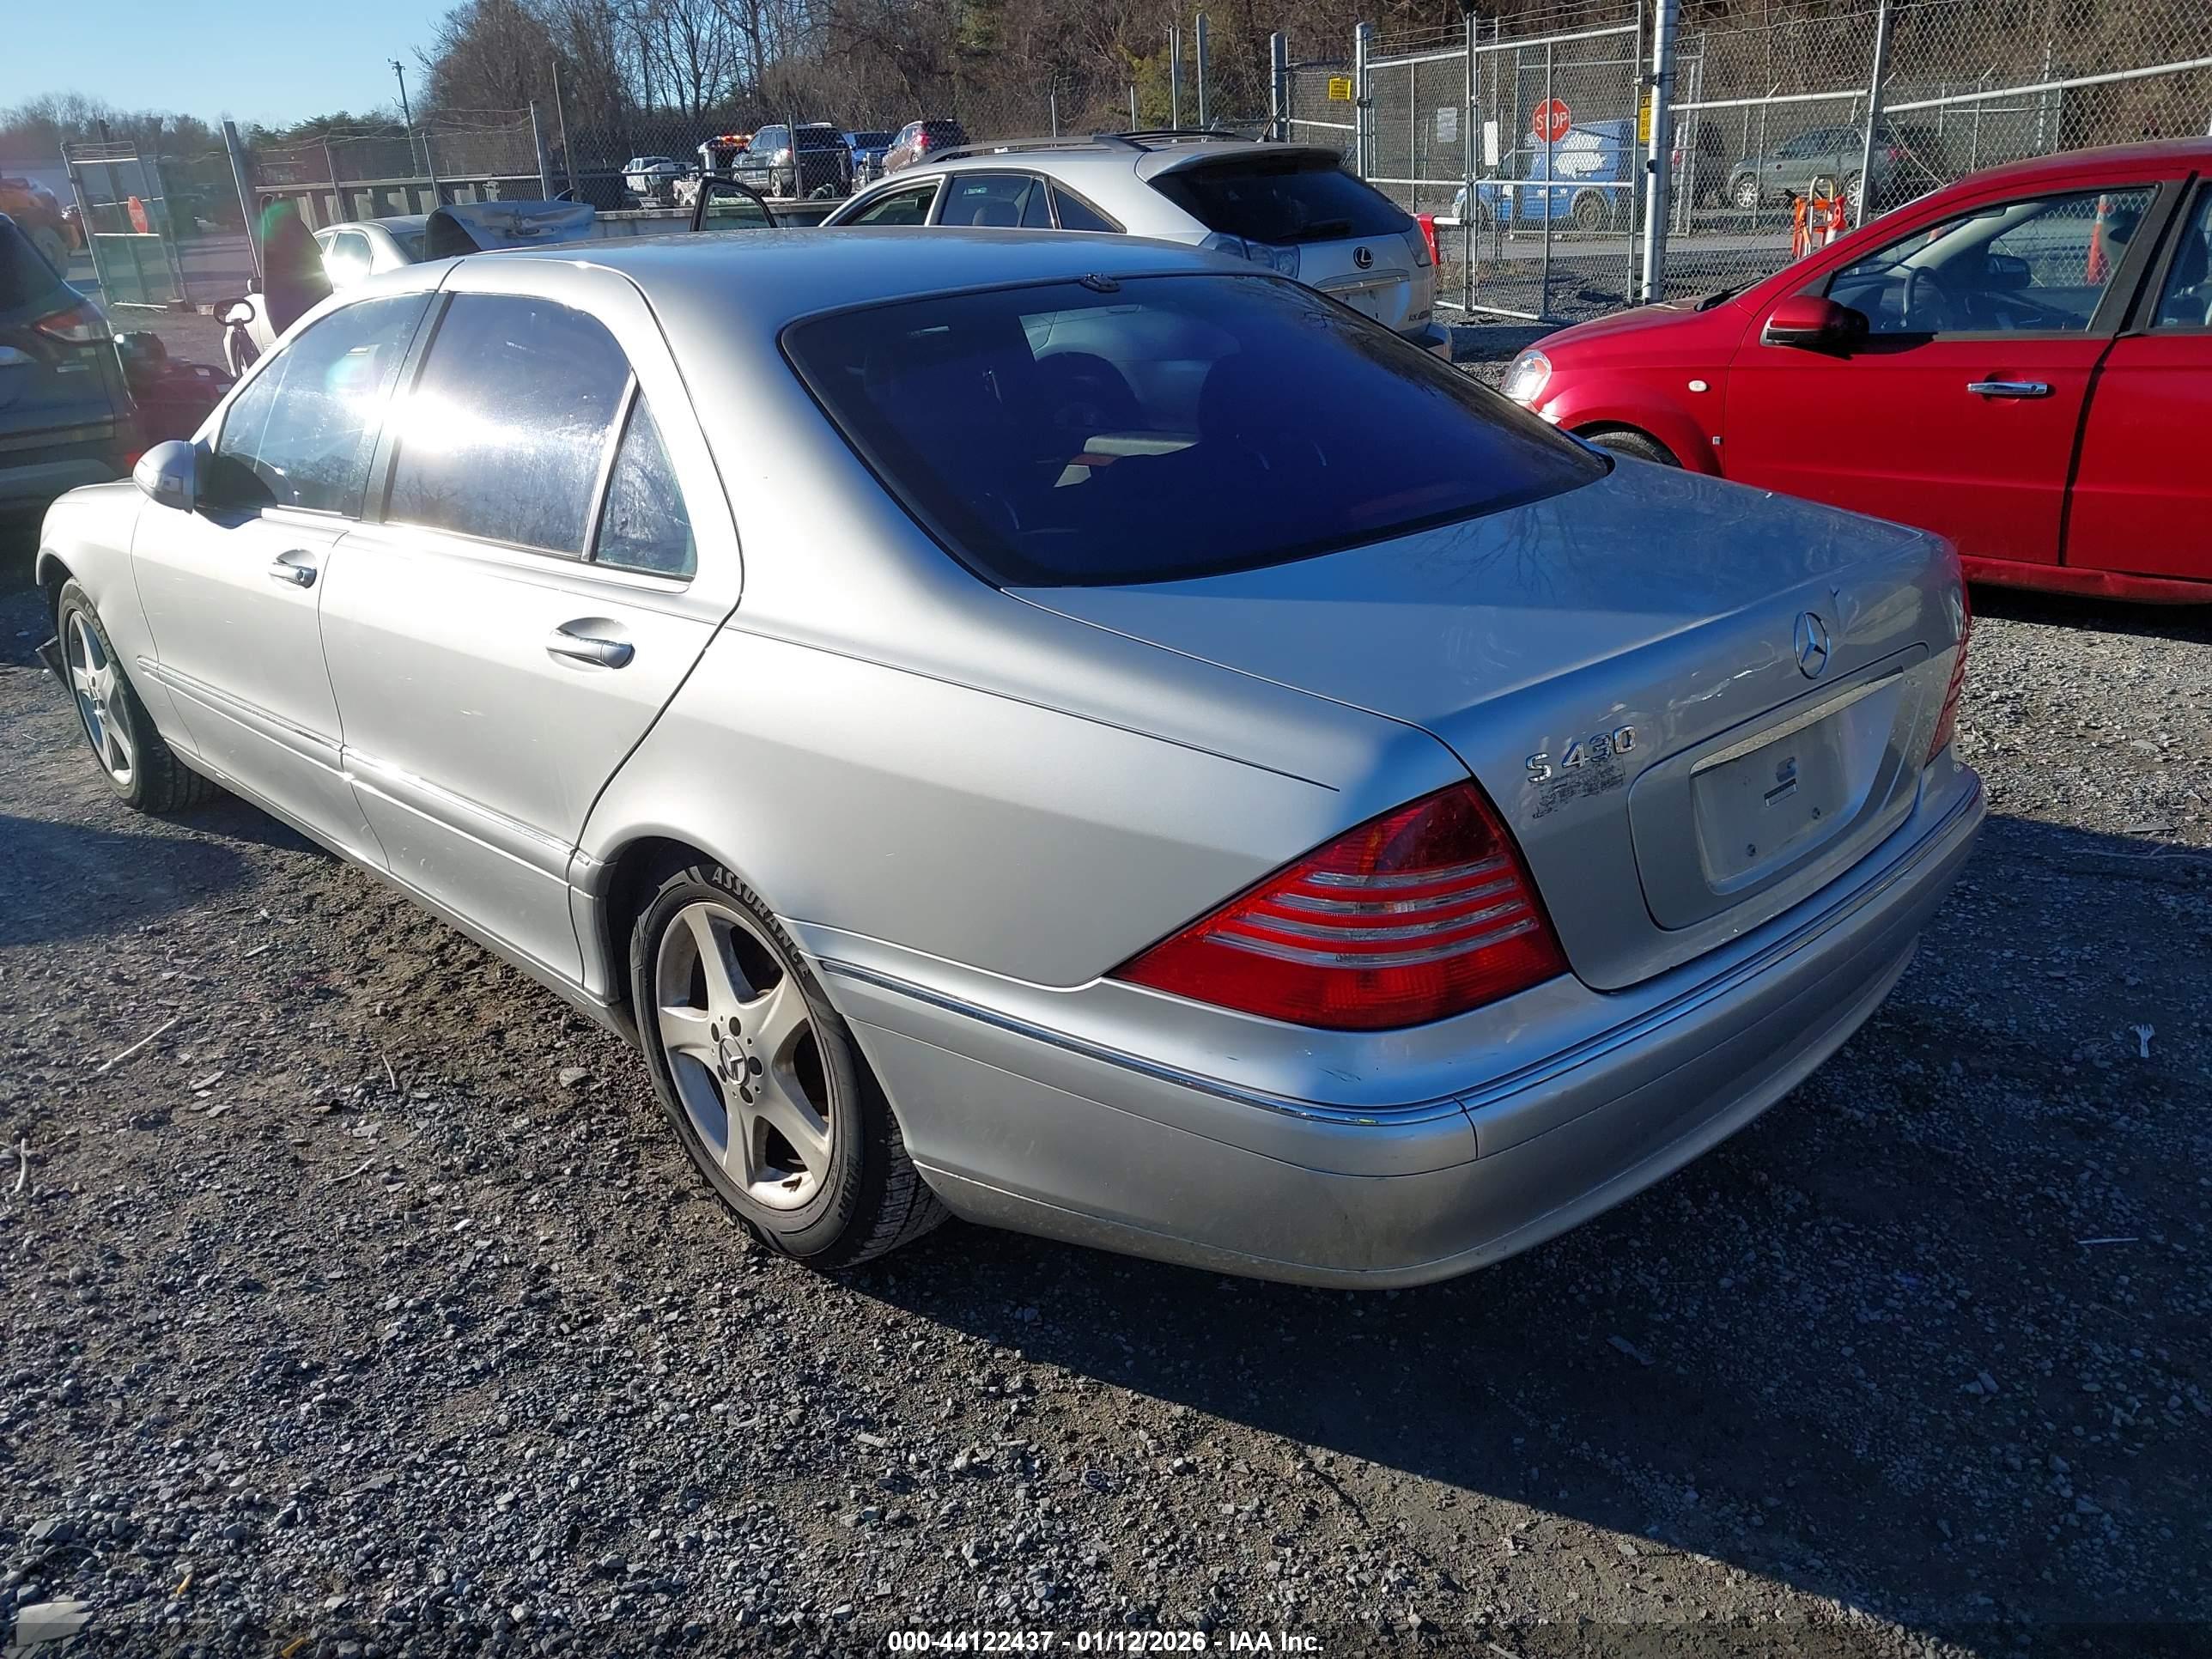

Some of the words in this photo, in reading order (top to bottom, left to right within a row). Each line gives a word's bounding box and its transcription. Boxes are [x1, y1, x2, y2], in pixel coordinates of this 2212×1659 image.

[1526, 753, 1553, 782] S
[1562, 725, 1637, 769] 430
[711, 866, 811, 977] ASSURANCE
